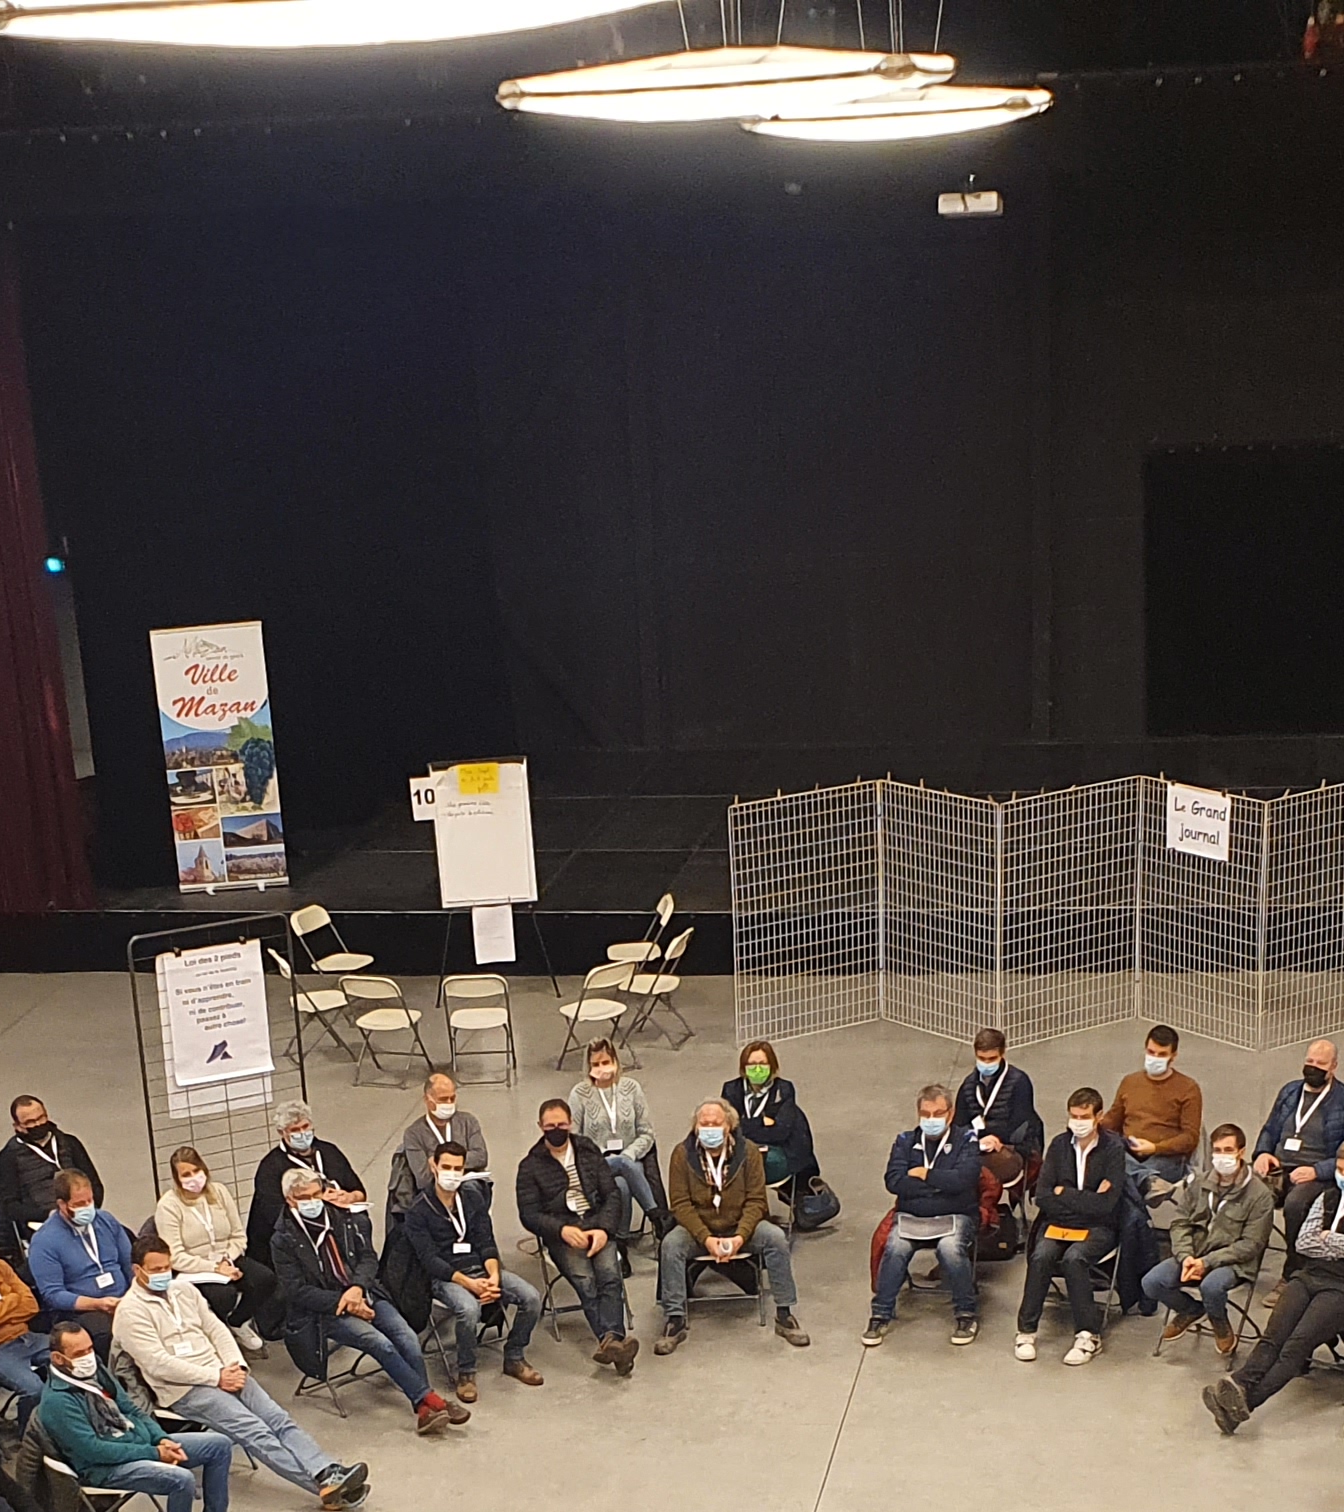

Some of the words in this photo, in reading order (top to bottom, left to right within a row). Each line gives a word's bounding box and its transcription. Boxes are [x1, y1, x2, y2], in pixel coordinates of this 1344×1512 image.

[184, 664, 238, 685] Ville
[206, 686, 218, 695] de
[172, 696, 257, 722] Mazan
[413, 789, 435, 805] 10
[1174, 796, 1186, 812] Le
[1191, 800, 1227, 821] Grand
[198, 956, 212, 964] des
[221, 952, 241, 962] pieds
